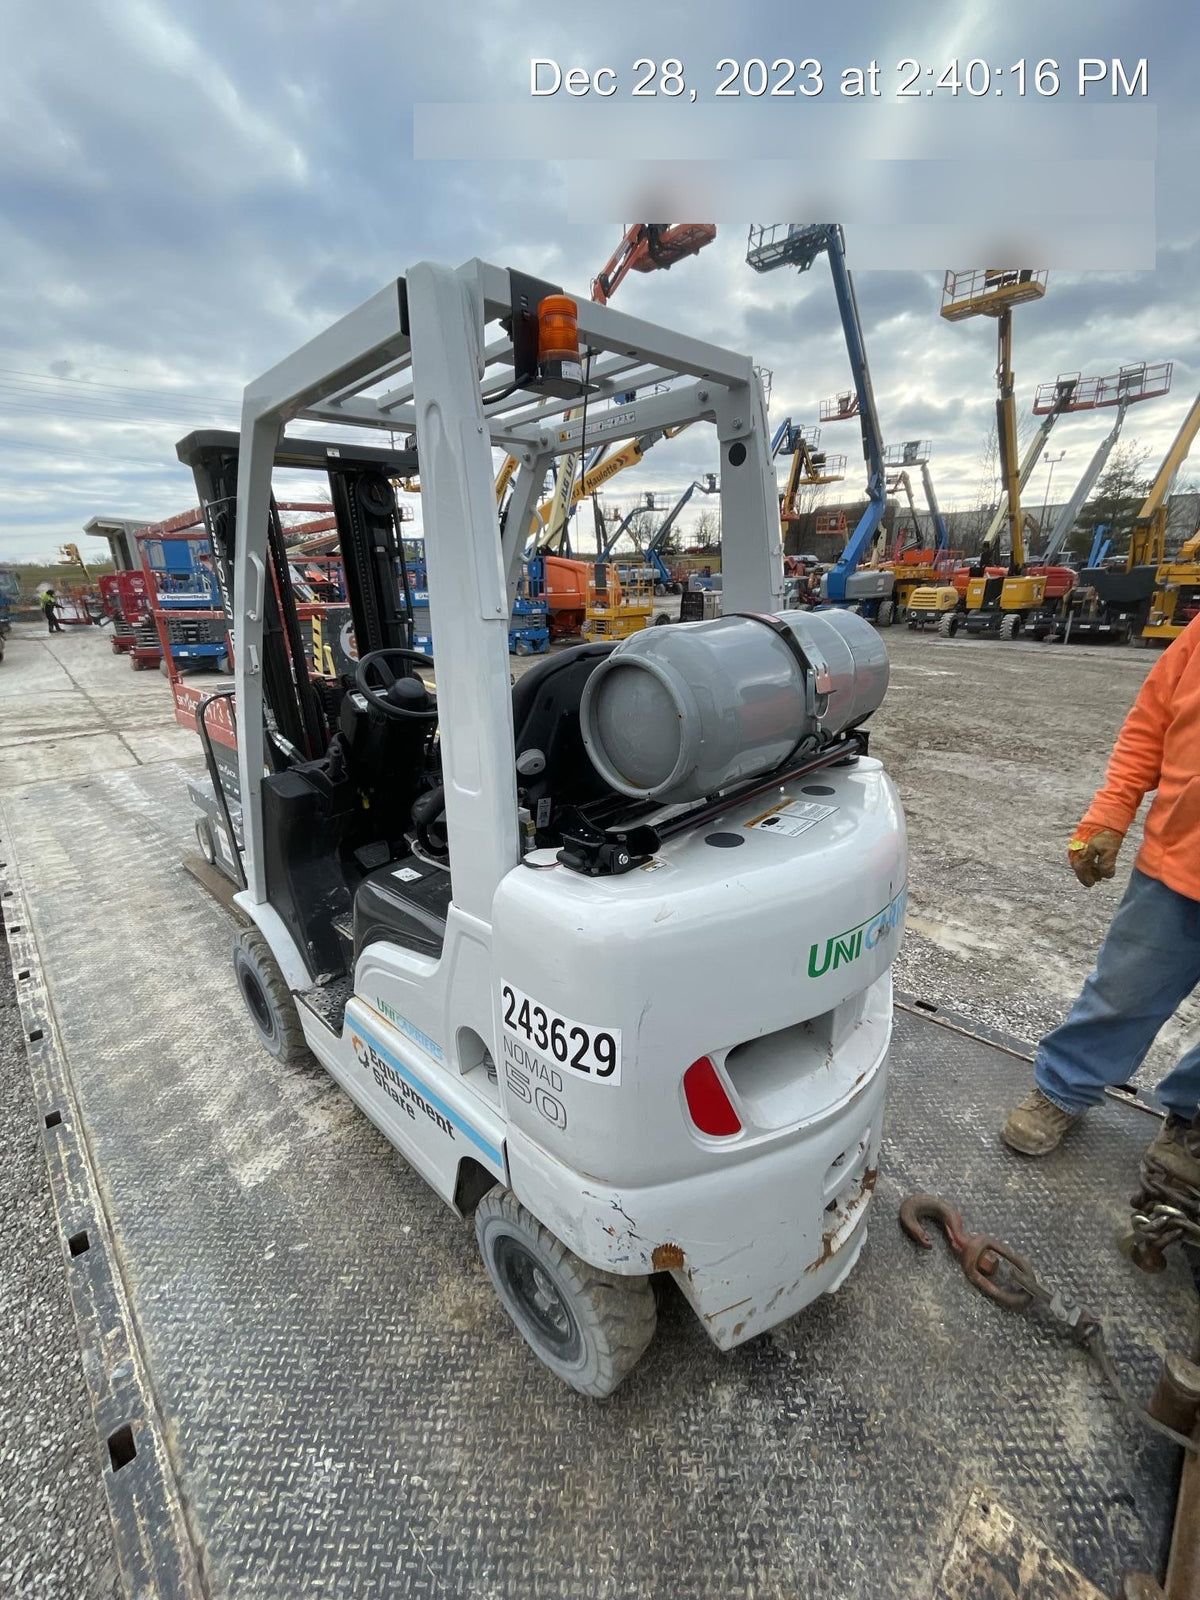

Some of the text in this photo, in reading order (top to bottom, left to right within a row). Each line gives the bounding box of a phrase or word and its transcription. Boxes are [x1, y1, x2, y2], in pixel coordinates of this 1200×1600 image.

[586, 463, 618, 489] Haulotte
[376, 996, 444, 1060] UNICARRIERS
[502, 985, 617, 1078] 243629
[368, 1045, 456, 1141] Equipment
[372, 1066, 416, 1121] Share
[503, 1035, 563, 1092] NOMAD
[505, 1060, 567, 1131] 50
